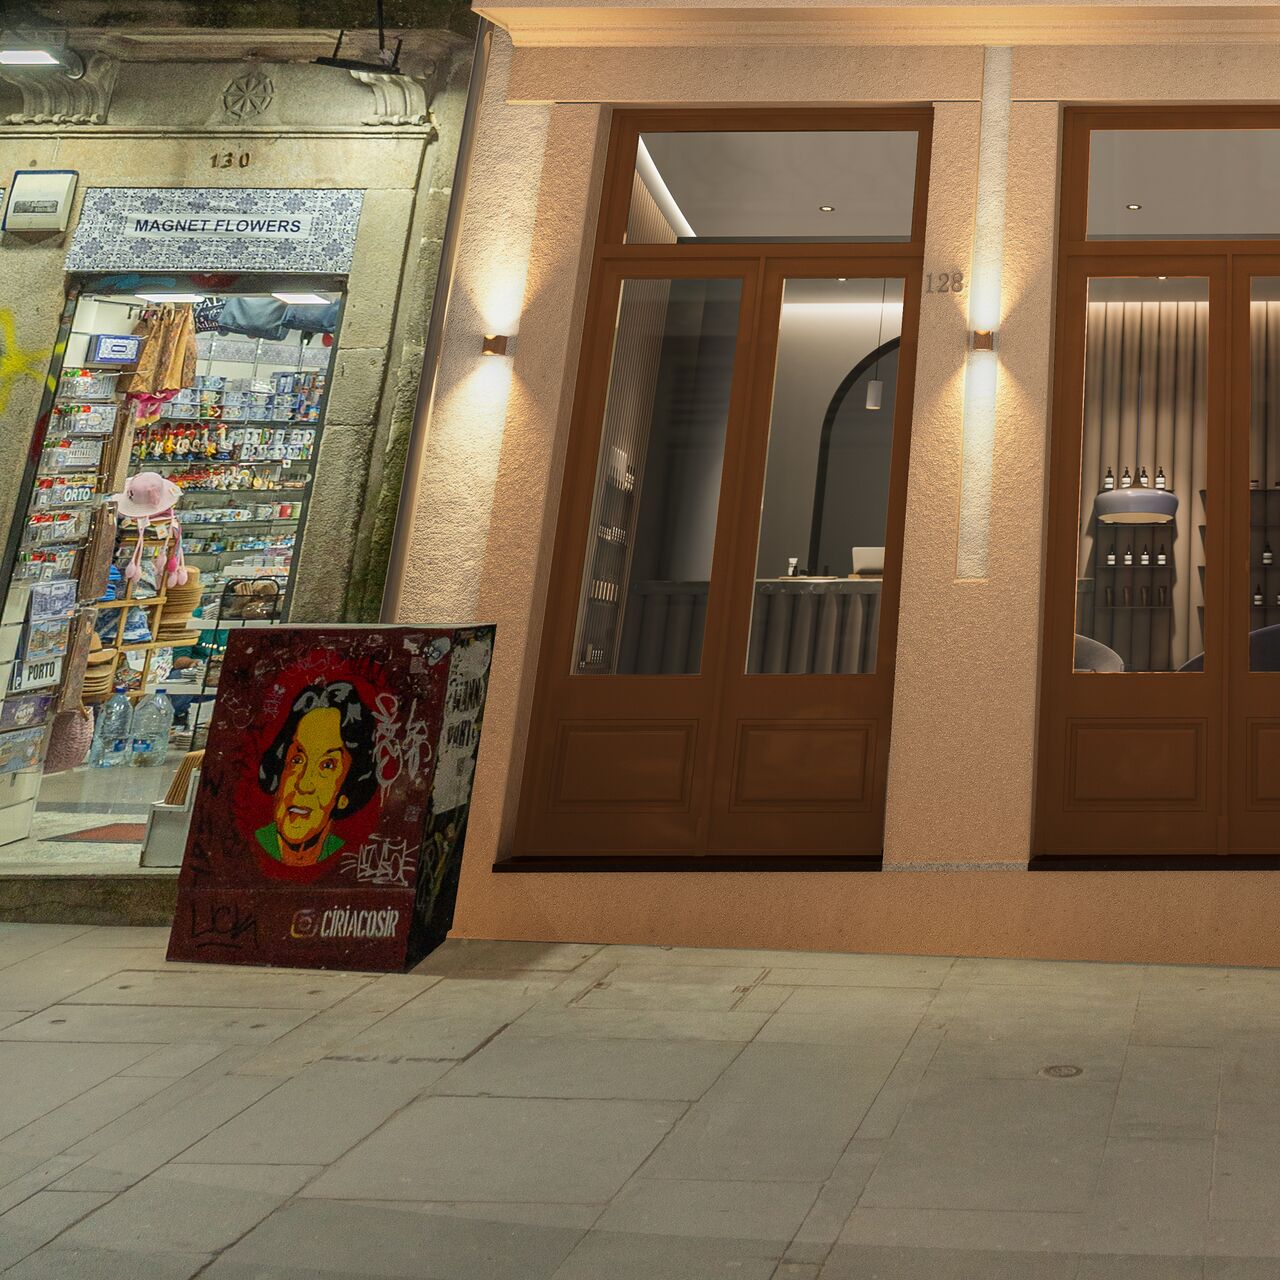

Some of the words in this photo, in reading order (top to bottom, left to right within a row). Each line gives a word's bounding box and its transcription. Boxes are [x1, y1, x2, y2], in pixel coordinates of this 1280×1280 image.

[210, 152, 250, 168] 130
[134, 219, 211, 232] MAGNET
[214, 219, 301, 233] FLOWERS
[926, 272, 964, 293] 128
[28, 661, 56, 681] PORTO
